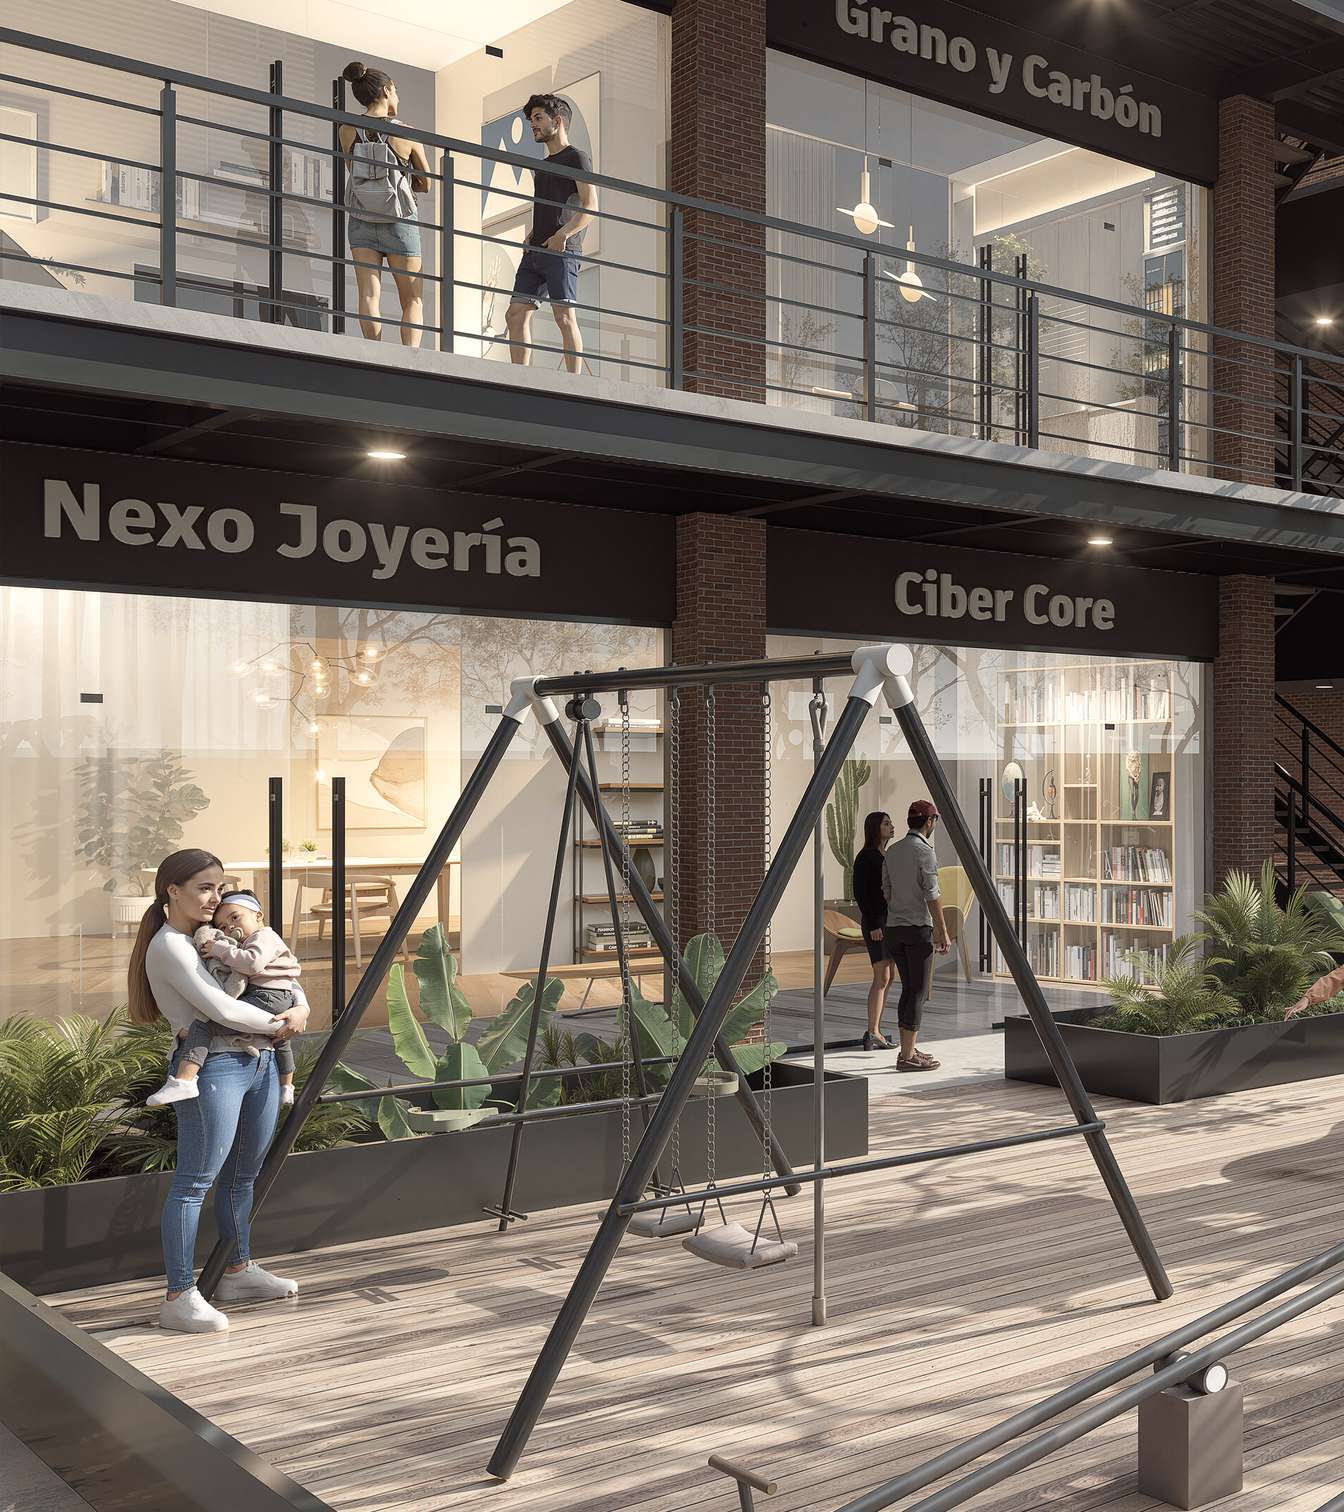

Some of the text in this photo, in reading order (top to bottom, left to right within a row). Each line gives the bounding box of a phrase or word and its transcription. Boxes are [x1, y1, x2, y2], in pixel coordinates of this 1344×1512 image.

[835, 0, 1163, 138] Grano y Carbón
[43, 478, 541, 580] Nexo Joyería
[894, 568, 1115, 631] Ciber Core
